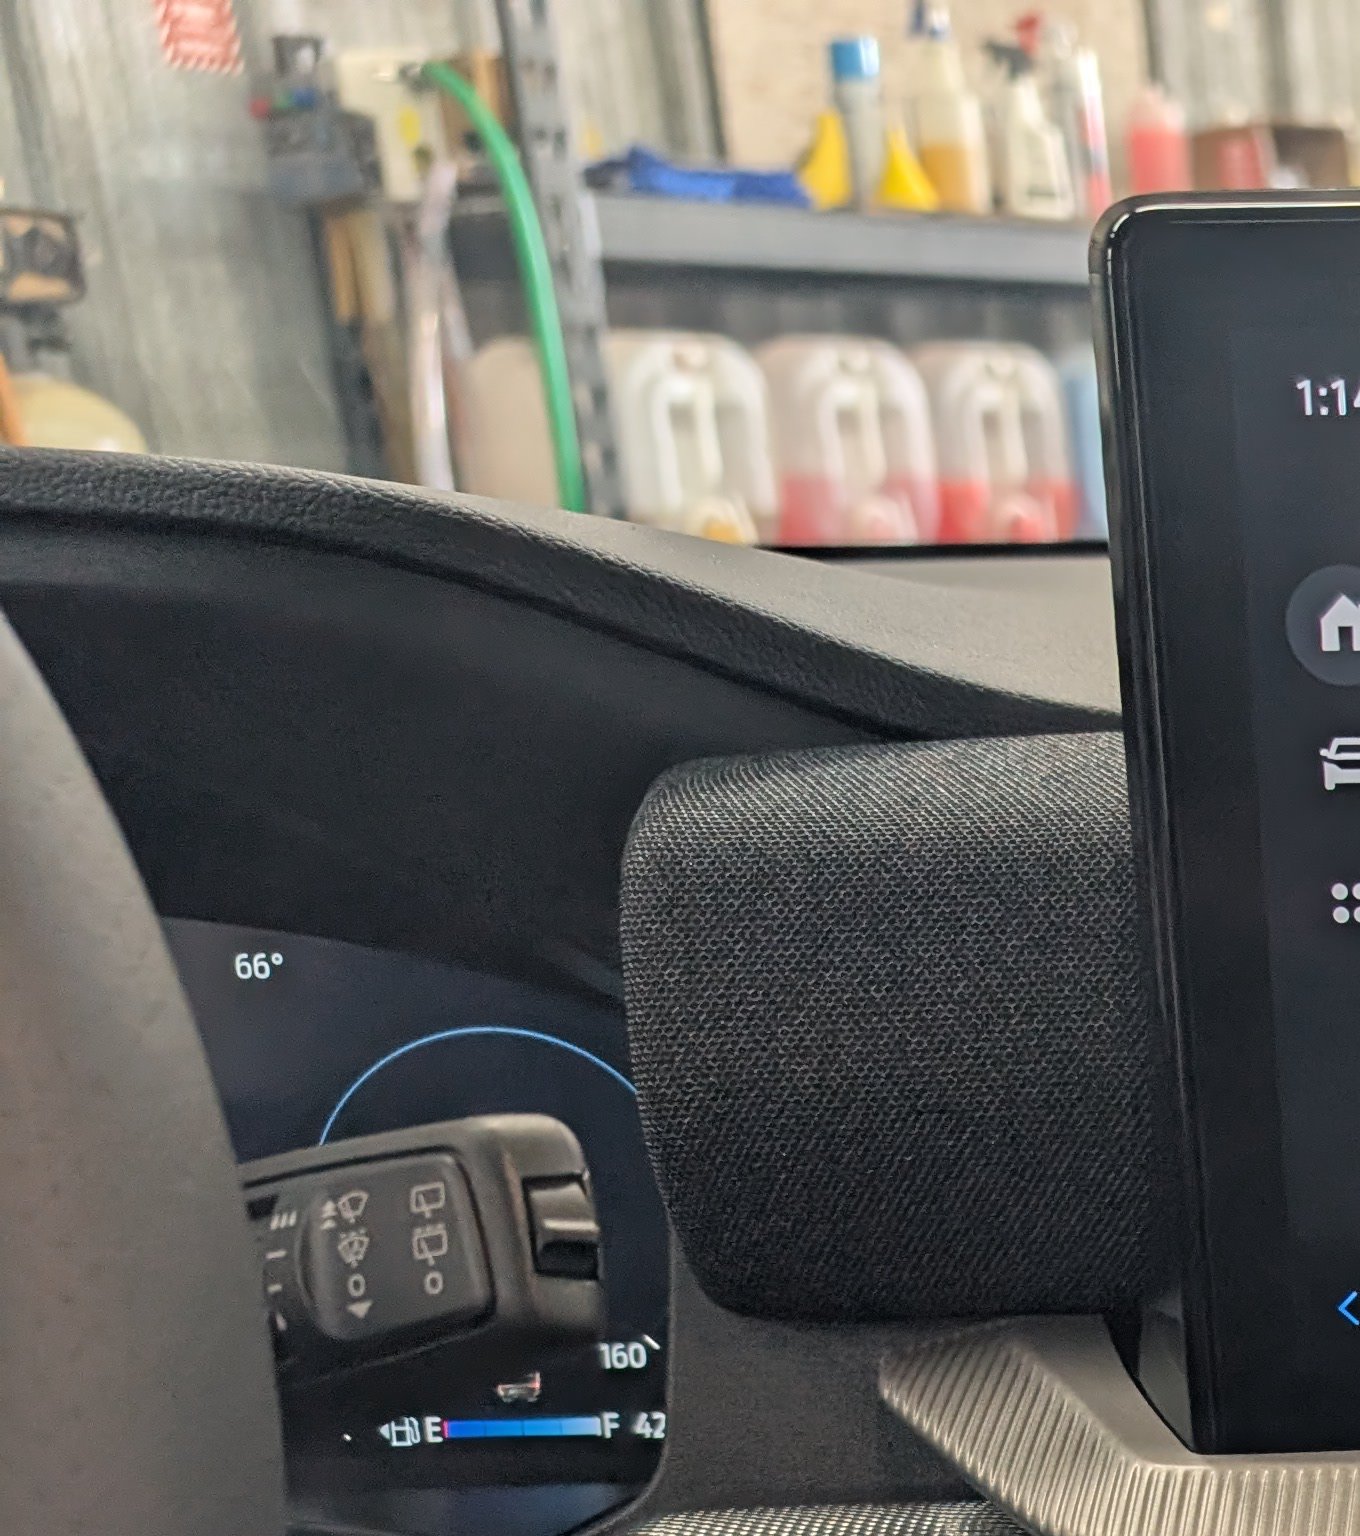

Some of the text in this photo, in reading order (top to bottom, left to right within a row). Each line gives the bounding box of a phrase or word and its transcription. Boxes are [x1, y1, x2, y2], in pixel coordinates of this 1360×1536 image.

[234, 952, 284, 980] 66°
[598, 1342, 647, 1370] 160
[423, 1415, 444, 1444] E
[602, 1411, 620, 1439] F
